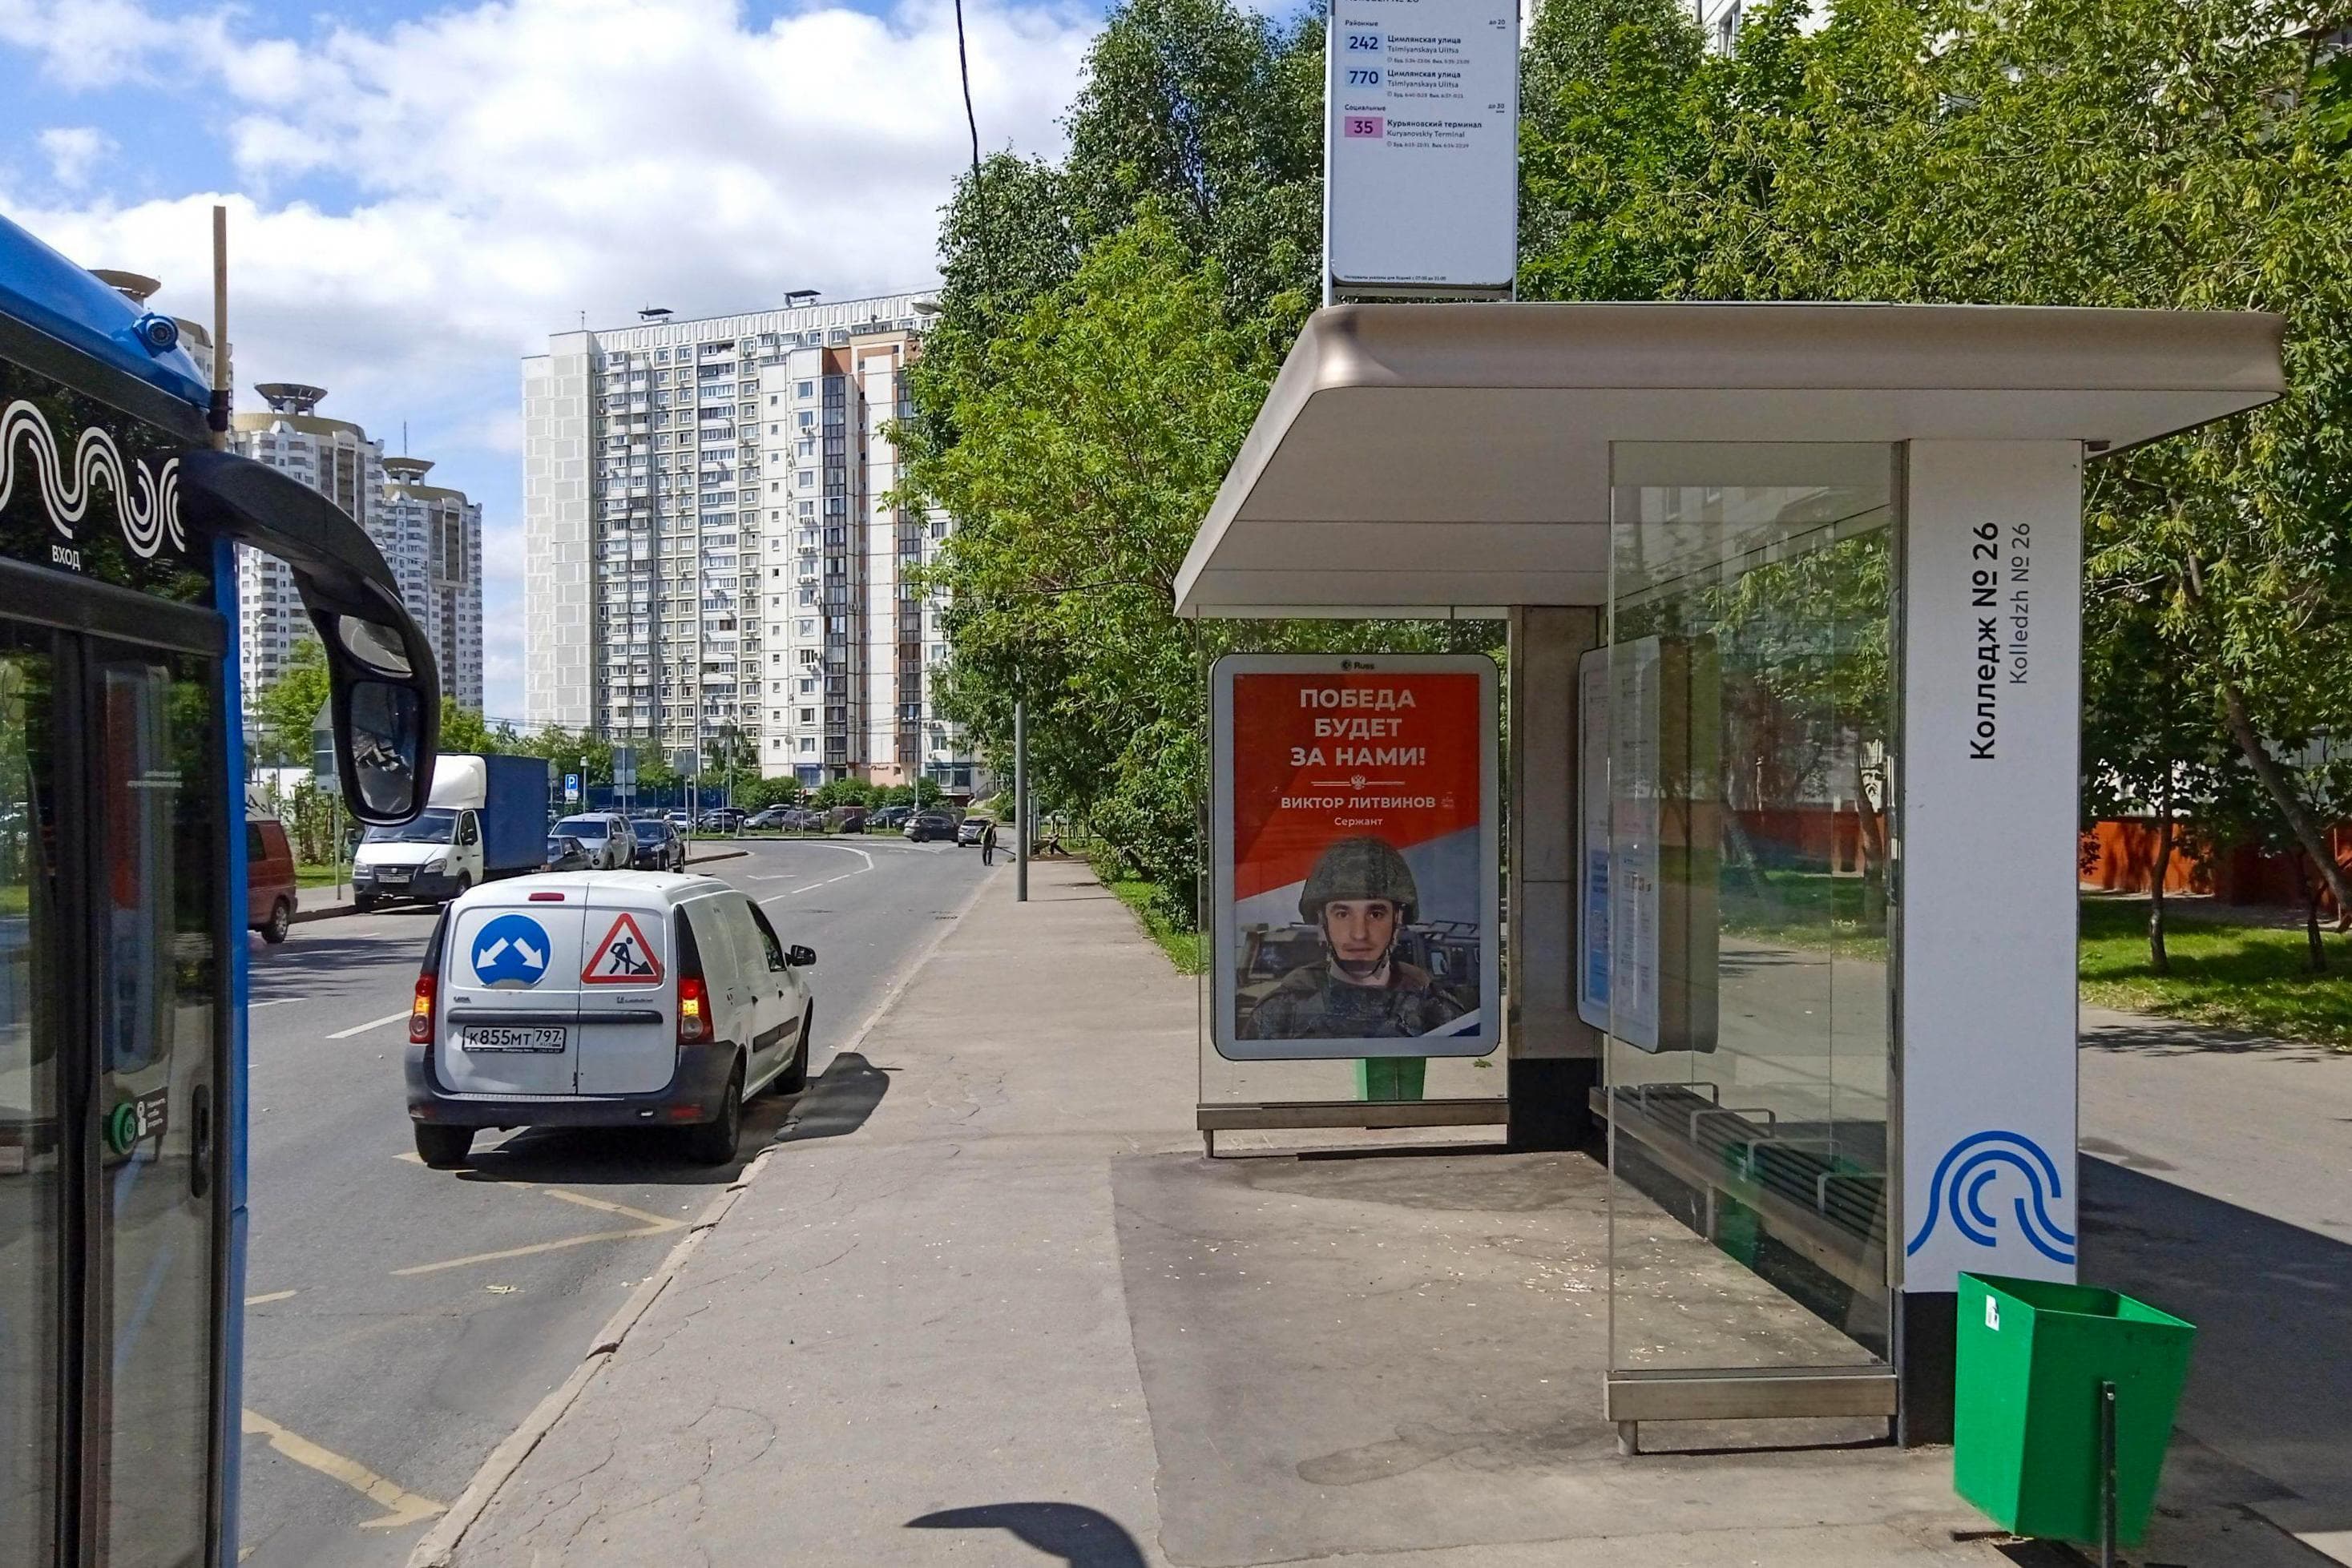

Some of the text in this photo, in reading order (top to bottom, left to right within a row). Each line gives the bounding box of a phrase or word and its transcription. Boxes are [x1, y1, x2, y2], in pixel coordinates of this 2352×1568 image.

[1349, 36, 1378, 50] 242
[1387, 35, 1461, 45] Цимлянская улица
[1387, 46, 1459, 54] Tsimlyanskaya Ulitsa
[1349, 71, 1379, 84] 770
[1387, 70, 1436, 78] Цимлянская
[1387, 80, 1459, 88] Tsimlyanskaya Ulitsa
[1354, 121, 1374, 134] 35
[1387, 119, 1442, 128] Курьяновский
[1387, 130, 1433, 138] Kuryanovskiy
[51, 545, 81, 570] ВХОД
[2010, 522, 2030, 683] Kolledzh № 26
[1970, 522, 2000, 760] Колледж № 26
[1300, 688, 1416, 710] ПОБЕДА
[1314, 718, 1402, 740] БУДЕТ
[1290, 747, 1426, 767] ЗА НАМИ!
[568, 776, 575, 788] P
[1281, 797, 1345, 809] ВИКТОР
[1348, 796, 1436, 808] ЛИТВИНОВ
[1333, 817, 1383, 827] Сержант
[535, 1030, 561, 1042] 797
